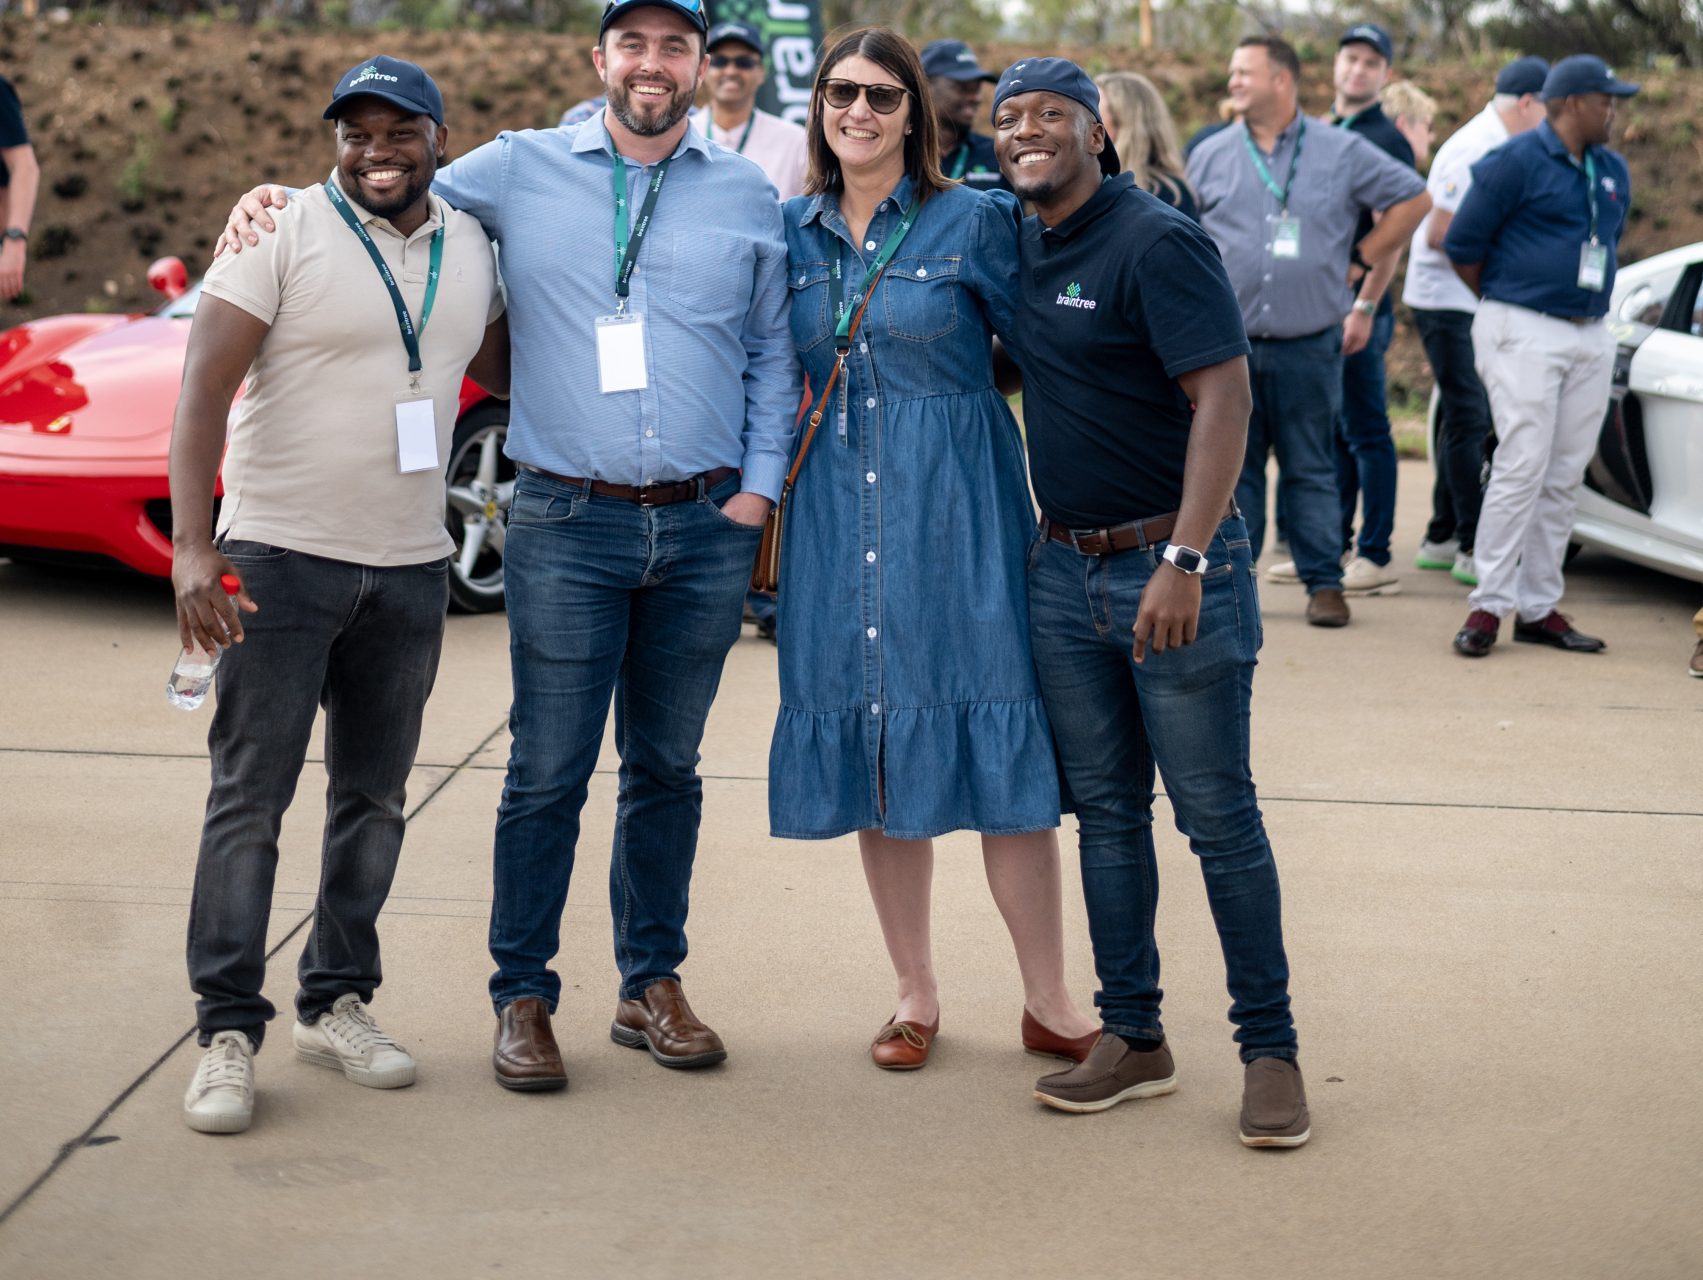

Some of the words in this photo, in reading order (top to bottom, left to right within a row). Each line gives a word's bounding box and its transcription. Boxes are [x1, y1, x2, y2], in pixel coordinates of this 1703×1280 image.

[653, 170, 665, 193] brantree
[637, 216, 649, 237] brantree
[381, 263, 395, 286] brantree
[622, 260, 633, 283] brantree
[1056, 292, 1096, 309] braintree
[402, 310, 412, 335] brantree
